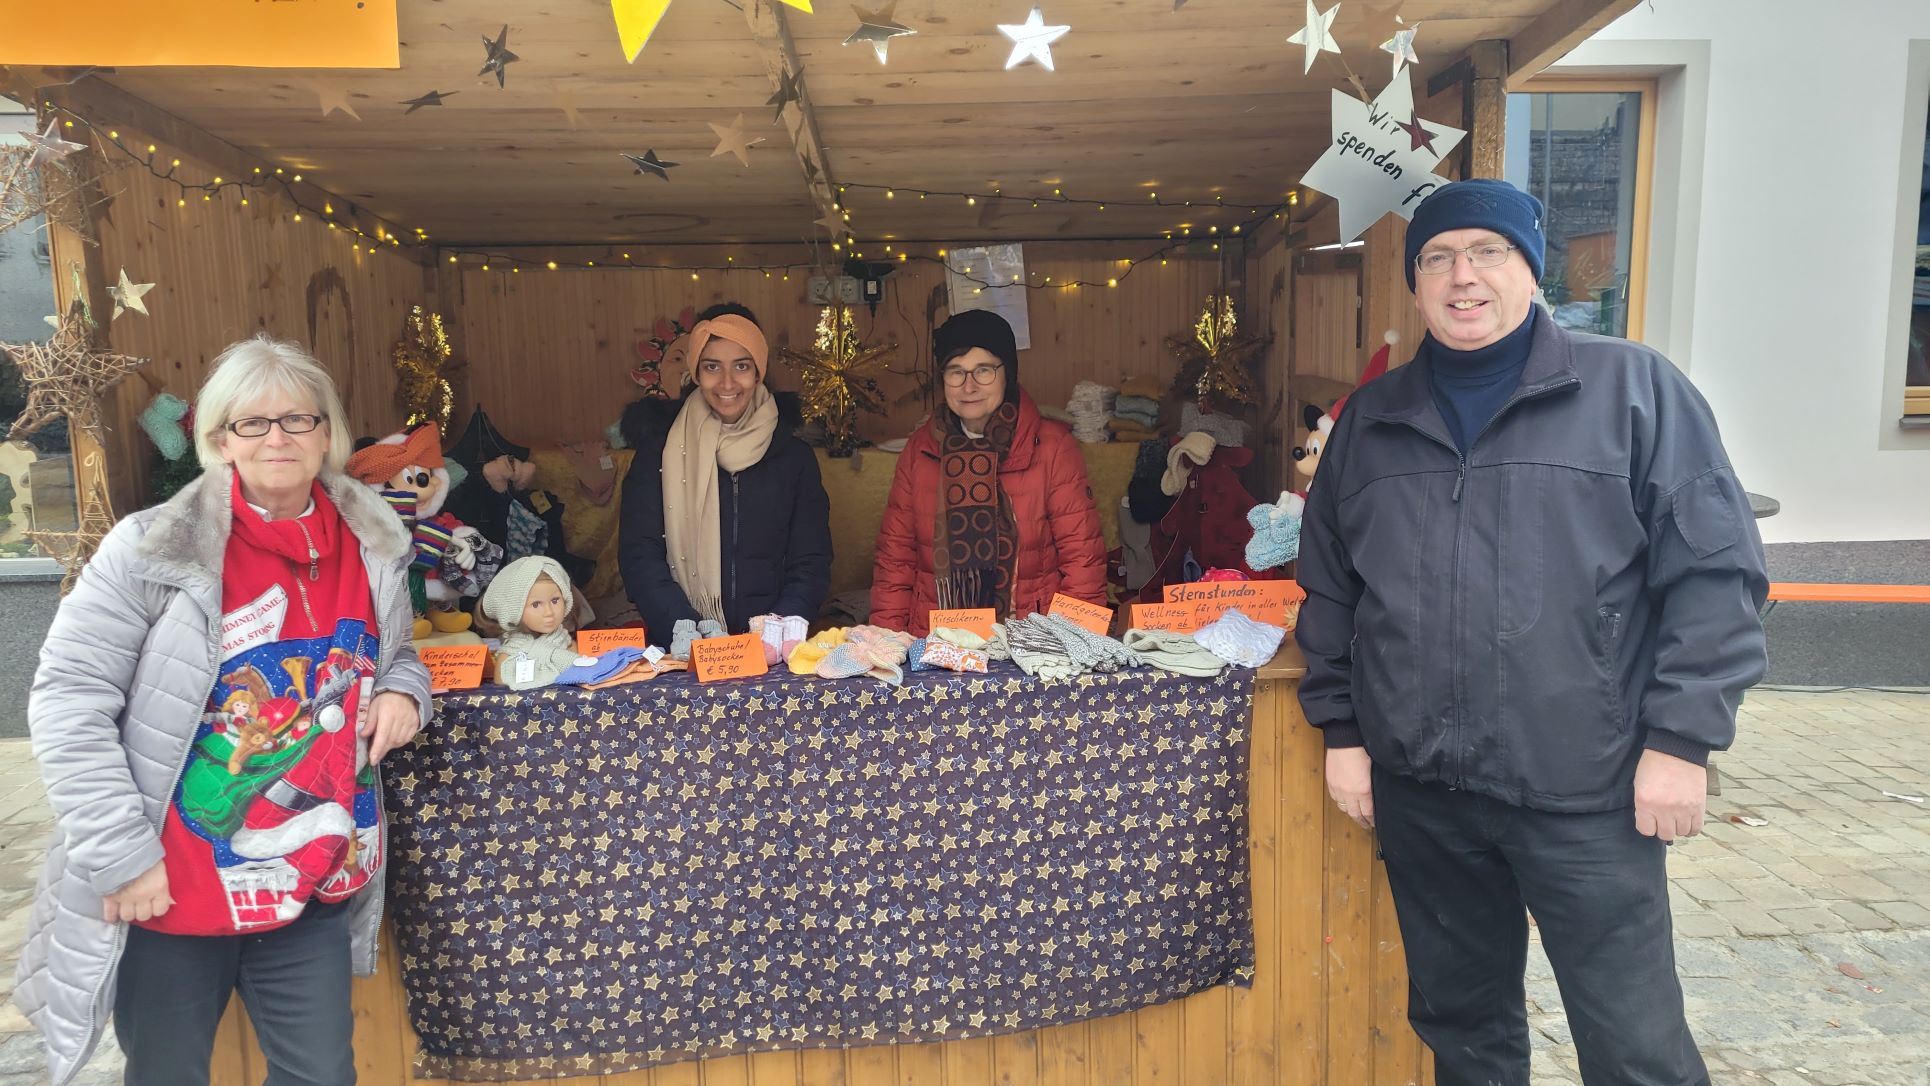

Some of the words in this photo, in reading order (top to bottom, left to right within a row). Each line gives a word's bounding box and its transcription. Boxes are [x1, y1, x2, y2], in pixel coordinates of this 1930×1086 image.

[1369, 103, 1400, 135] Wir
[1337, 132, 1403, 180] spenden
[1215, 601, 1244, 612] Kinder
[1248, 601, 1257, 609] in
[1142, 620, 1172, 630] Socken
[1177, 618, 1190, 629] ab
[423, 648, 481, 660] Kinderschal
[591, 643, 601, 653] ab
[698, 652, 744, 664] Babysocken
[718, 664, 740, 675] 5,90
